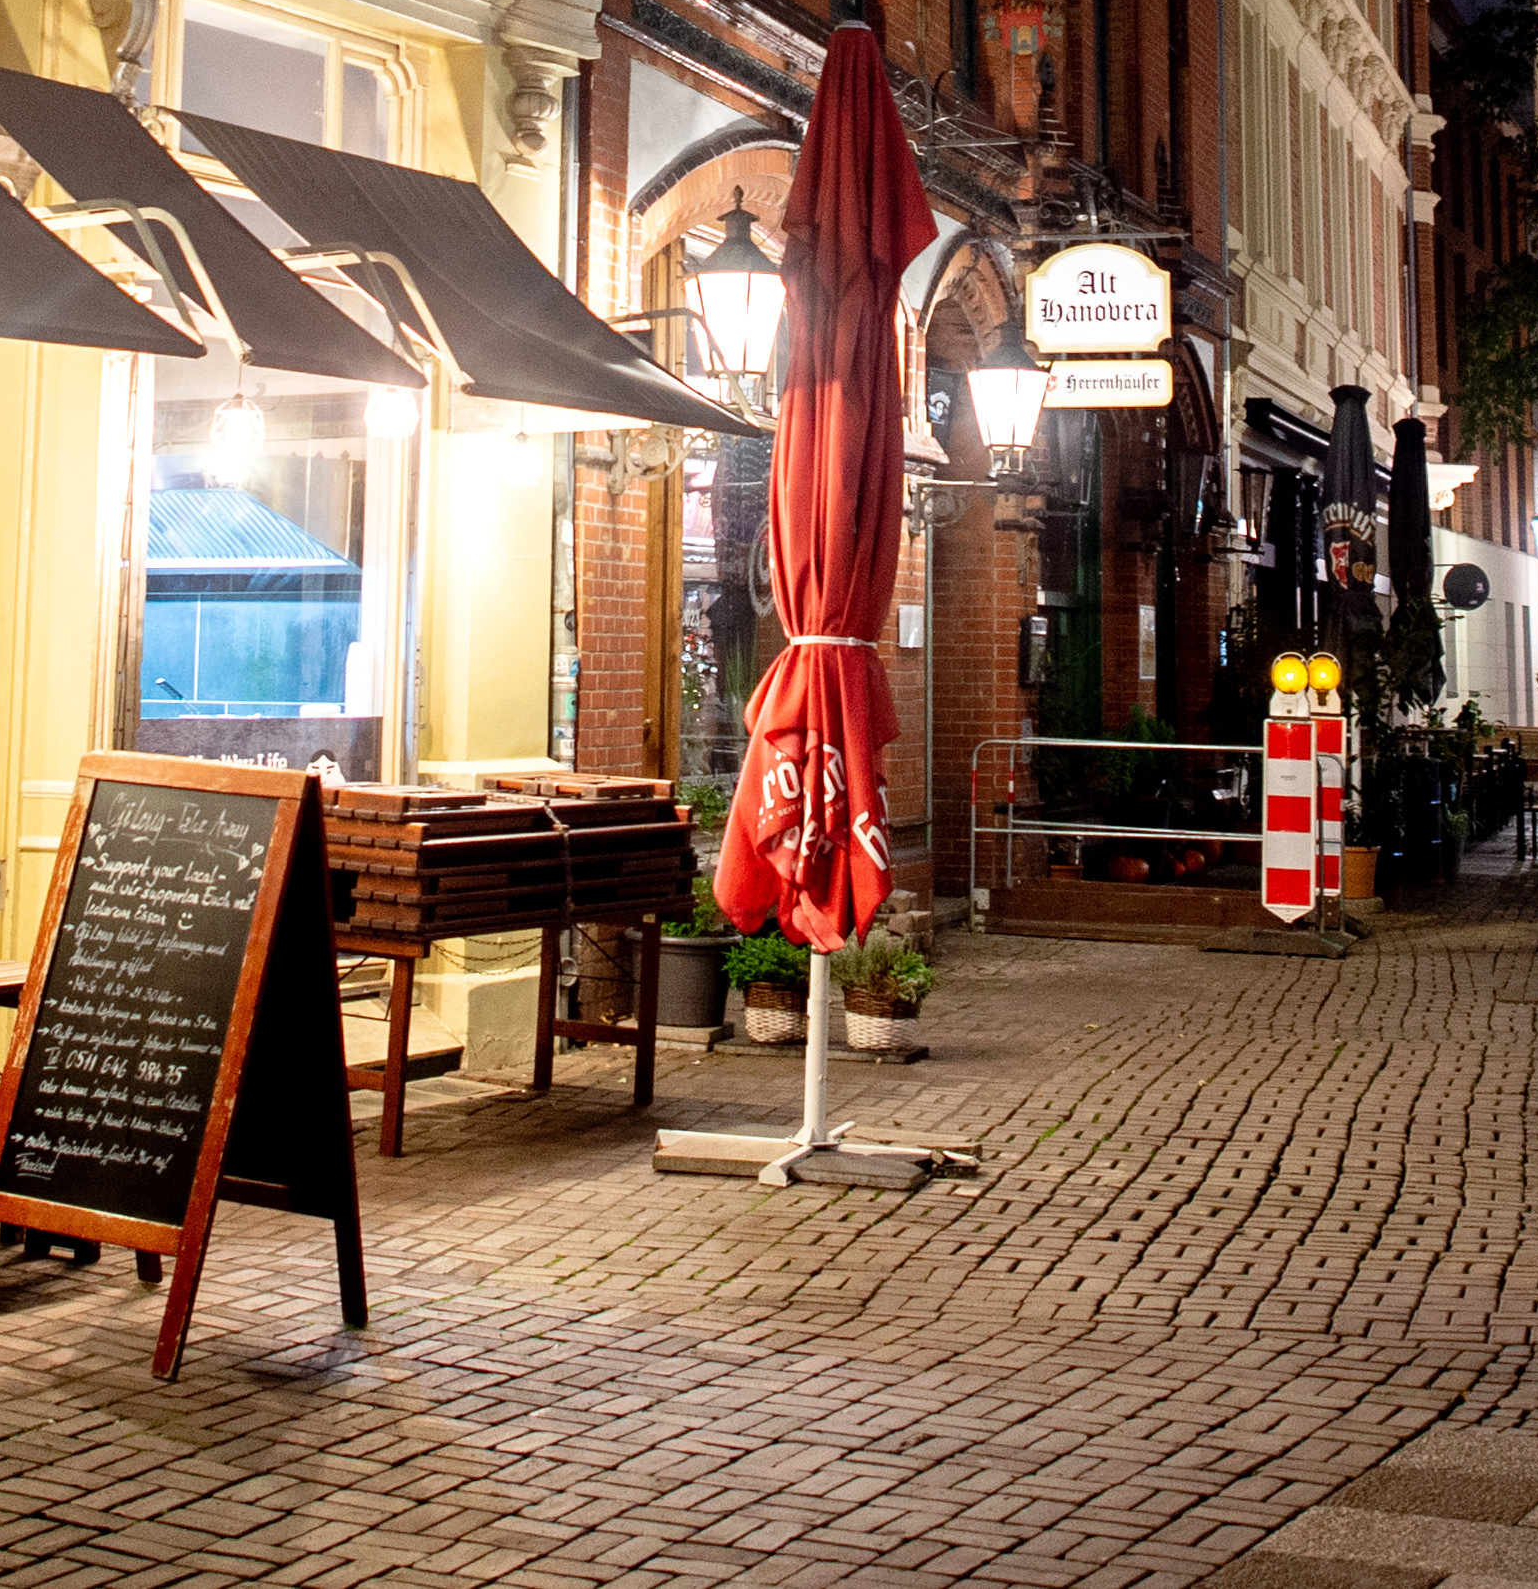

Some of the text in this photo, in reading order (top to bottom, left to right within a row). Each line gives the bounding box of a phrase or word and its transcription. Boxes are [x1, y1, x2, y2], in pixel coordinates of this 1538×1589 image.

[1076, 270, 1117, 295] Alt
[1040, 298, 1158, 327] Hanovera
[92, 852, 152, 881] Support
[146, 864, 183, 887] your
[89, 880, 117, 896] und
[119, 880, 142, 897] wir
[134, 903, 167, 926] Essen
[65, 1049, 99, 1072] 0511
